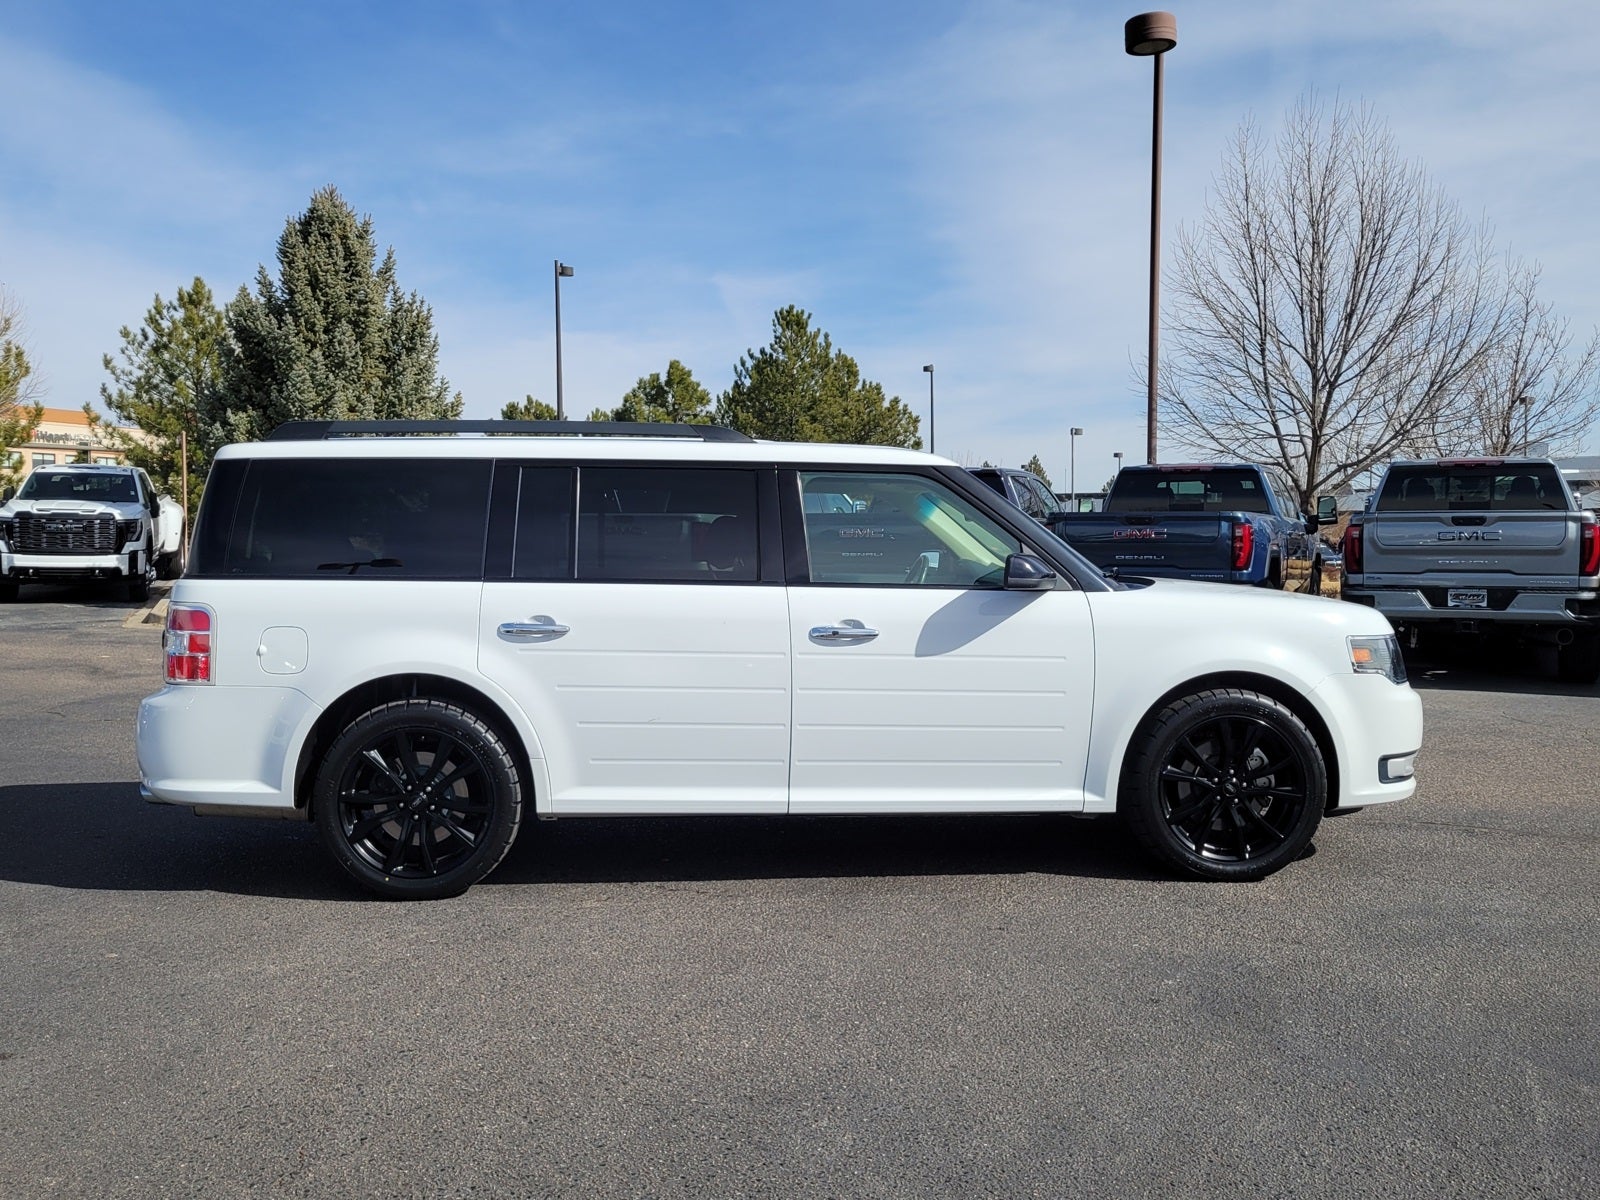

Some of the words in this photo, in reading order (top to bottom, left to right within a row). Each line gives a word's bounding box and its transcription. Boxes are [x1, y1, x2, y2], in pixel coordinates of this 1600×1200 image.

[840, 528, 884, 537] GMC
[1113, 528, 1167, 539] GMC
[1437, 530, 1502, 541] GMC
